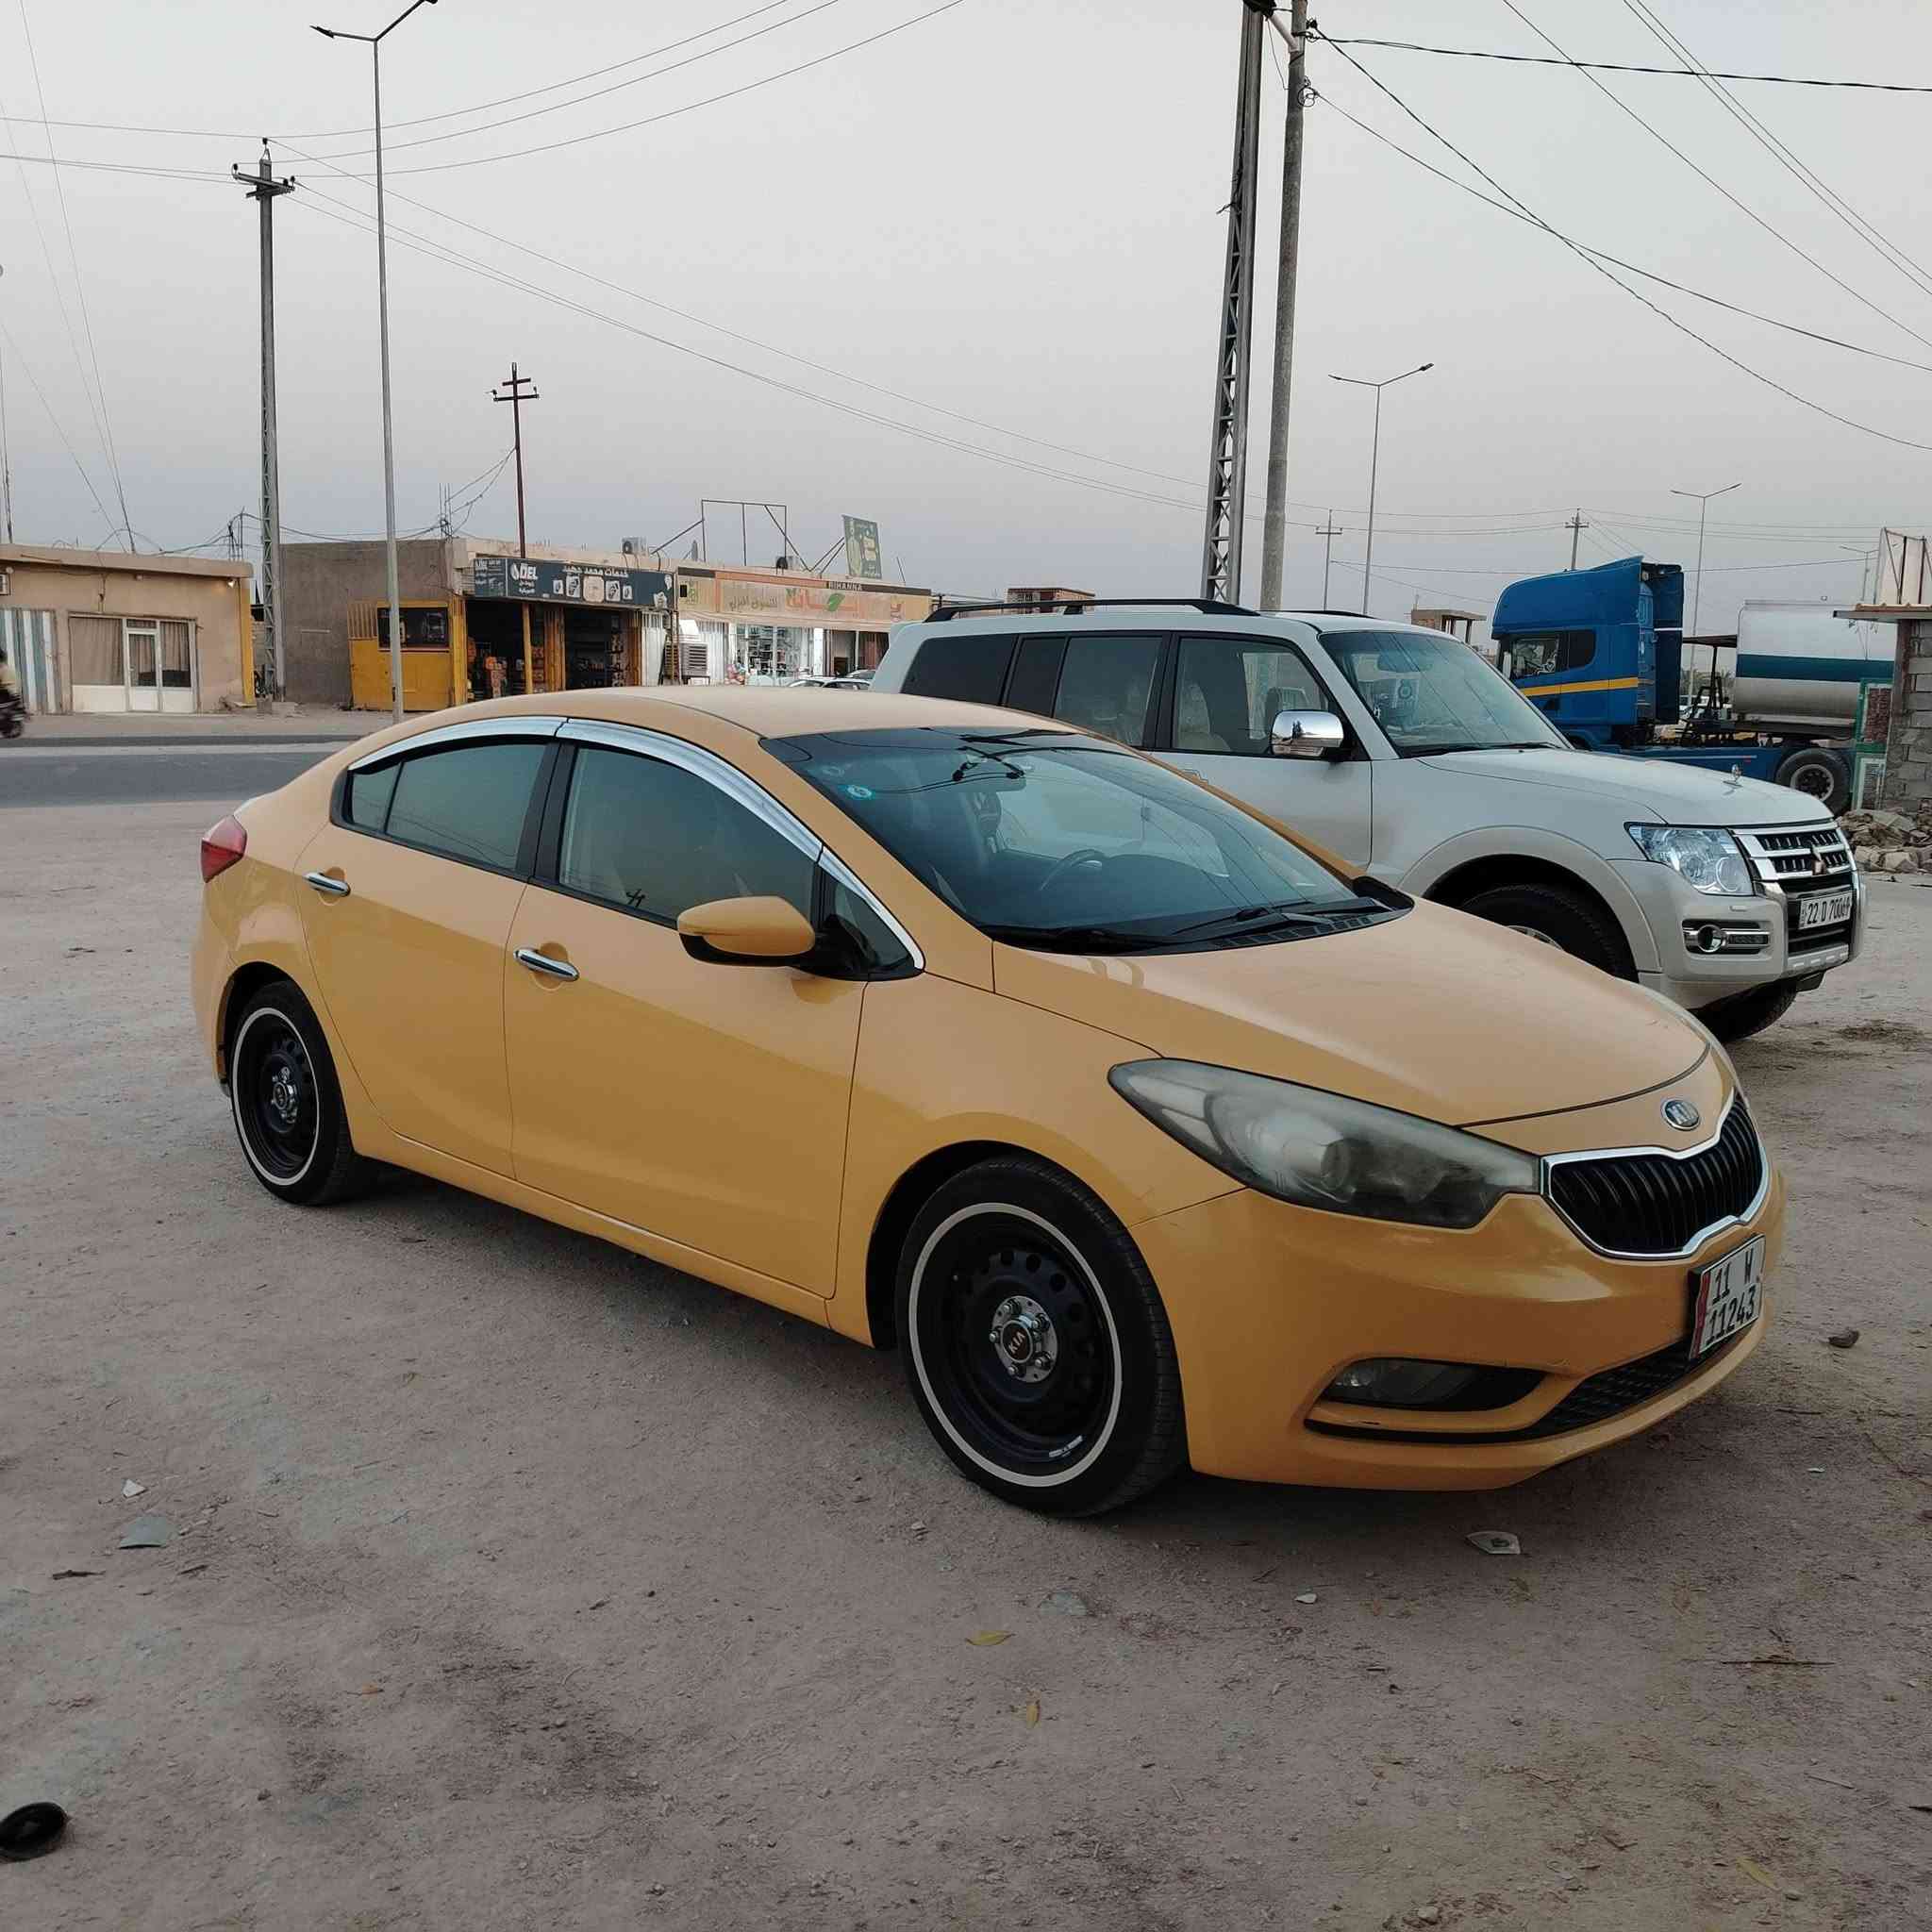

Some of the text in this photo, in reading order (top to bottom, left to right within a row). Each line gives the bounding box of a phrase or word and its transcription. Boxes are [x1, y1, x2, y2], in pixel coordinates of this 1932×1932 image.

[584, 567, 603, 575] محمد
[1807, 903, 1819, 924] 22
[1712, 1261, 1731, 1305] 11
[1706, 1285, 1756, 1344] 11243
[1008, 1331, 1026, 1354] KIA
